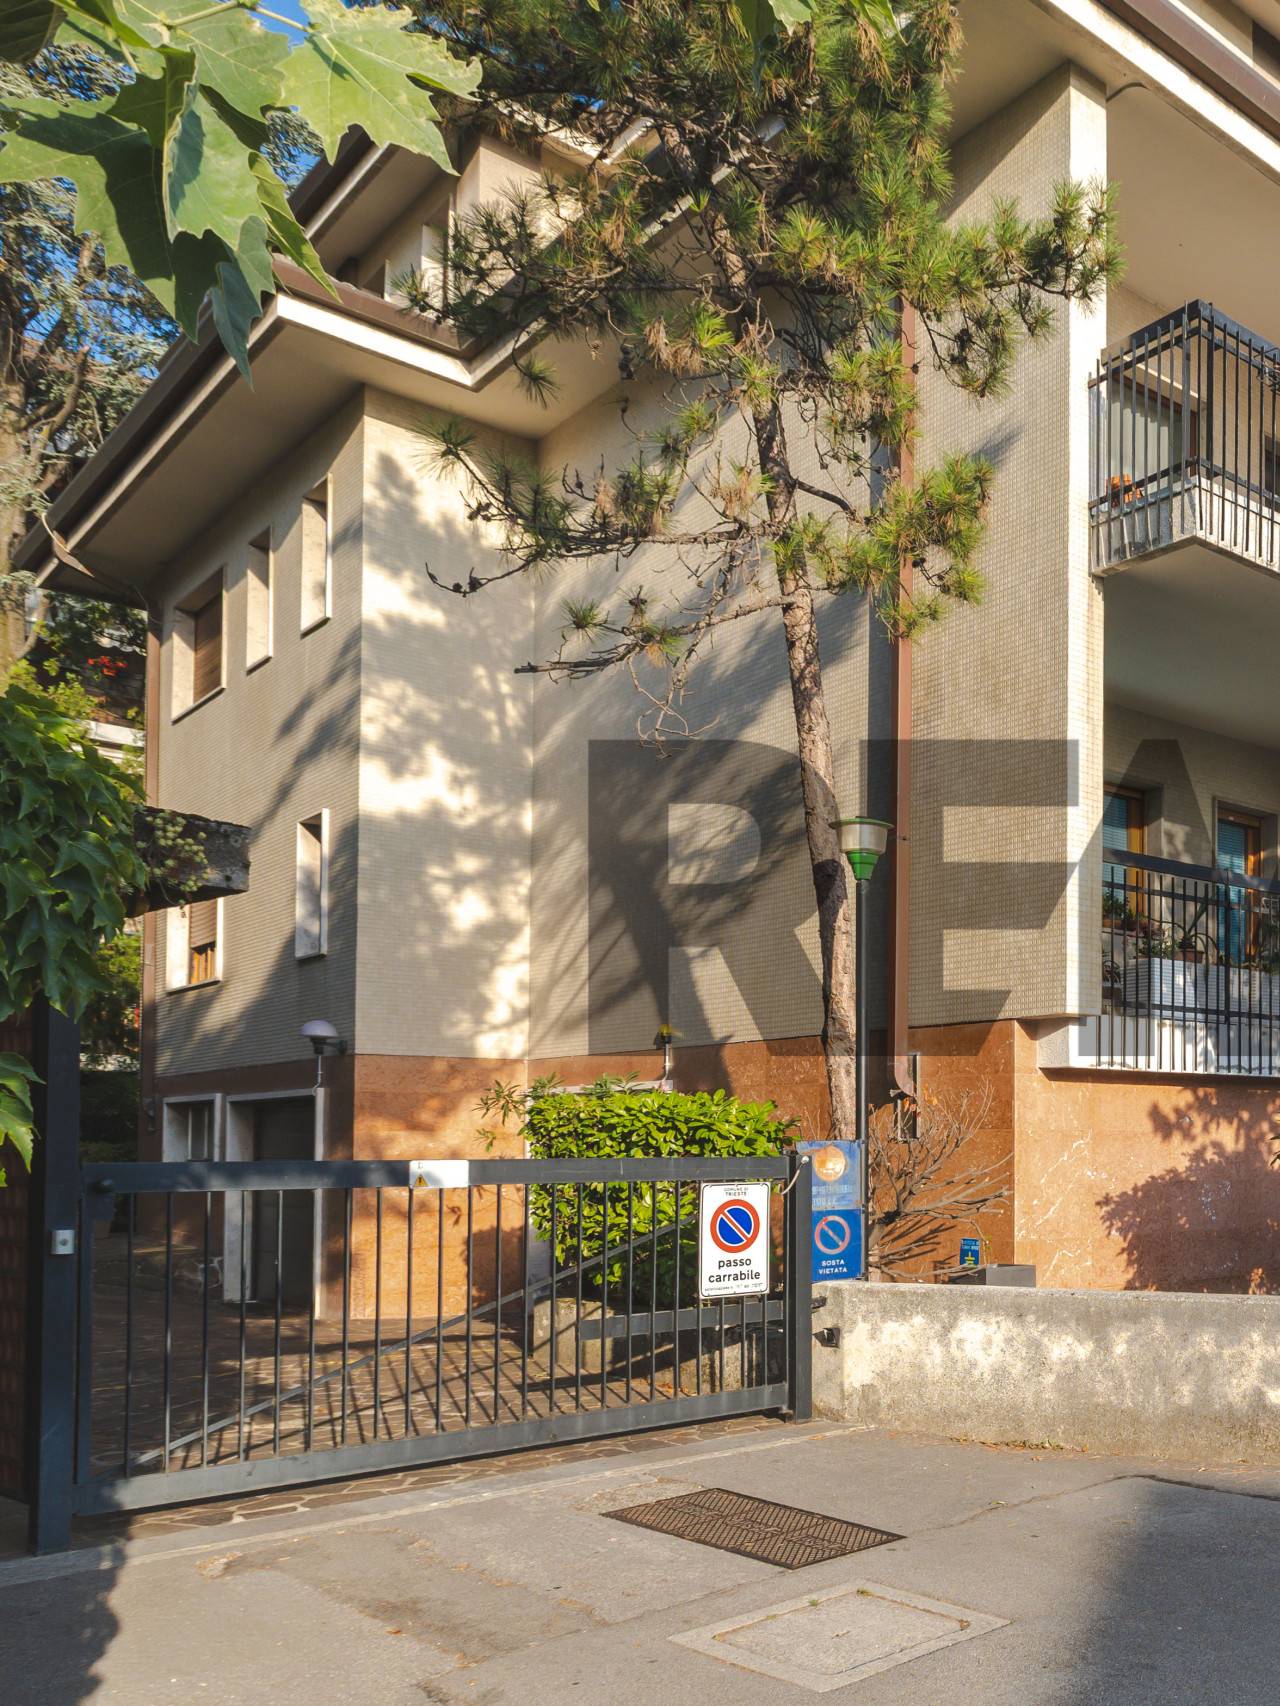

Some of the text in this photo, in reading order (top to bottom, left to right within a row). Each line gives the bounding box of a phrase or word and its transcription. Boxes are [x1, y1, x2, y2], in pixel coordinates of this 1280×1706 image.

[718, 1258, 752, 1270] passo
[821, 1259, 845, 1267] SOSTA
[818, 1267, 848, 1275] VIETATA
[708, 1270, 761, 1283] carrabile
